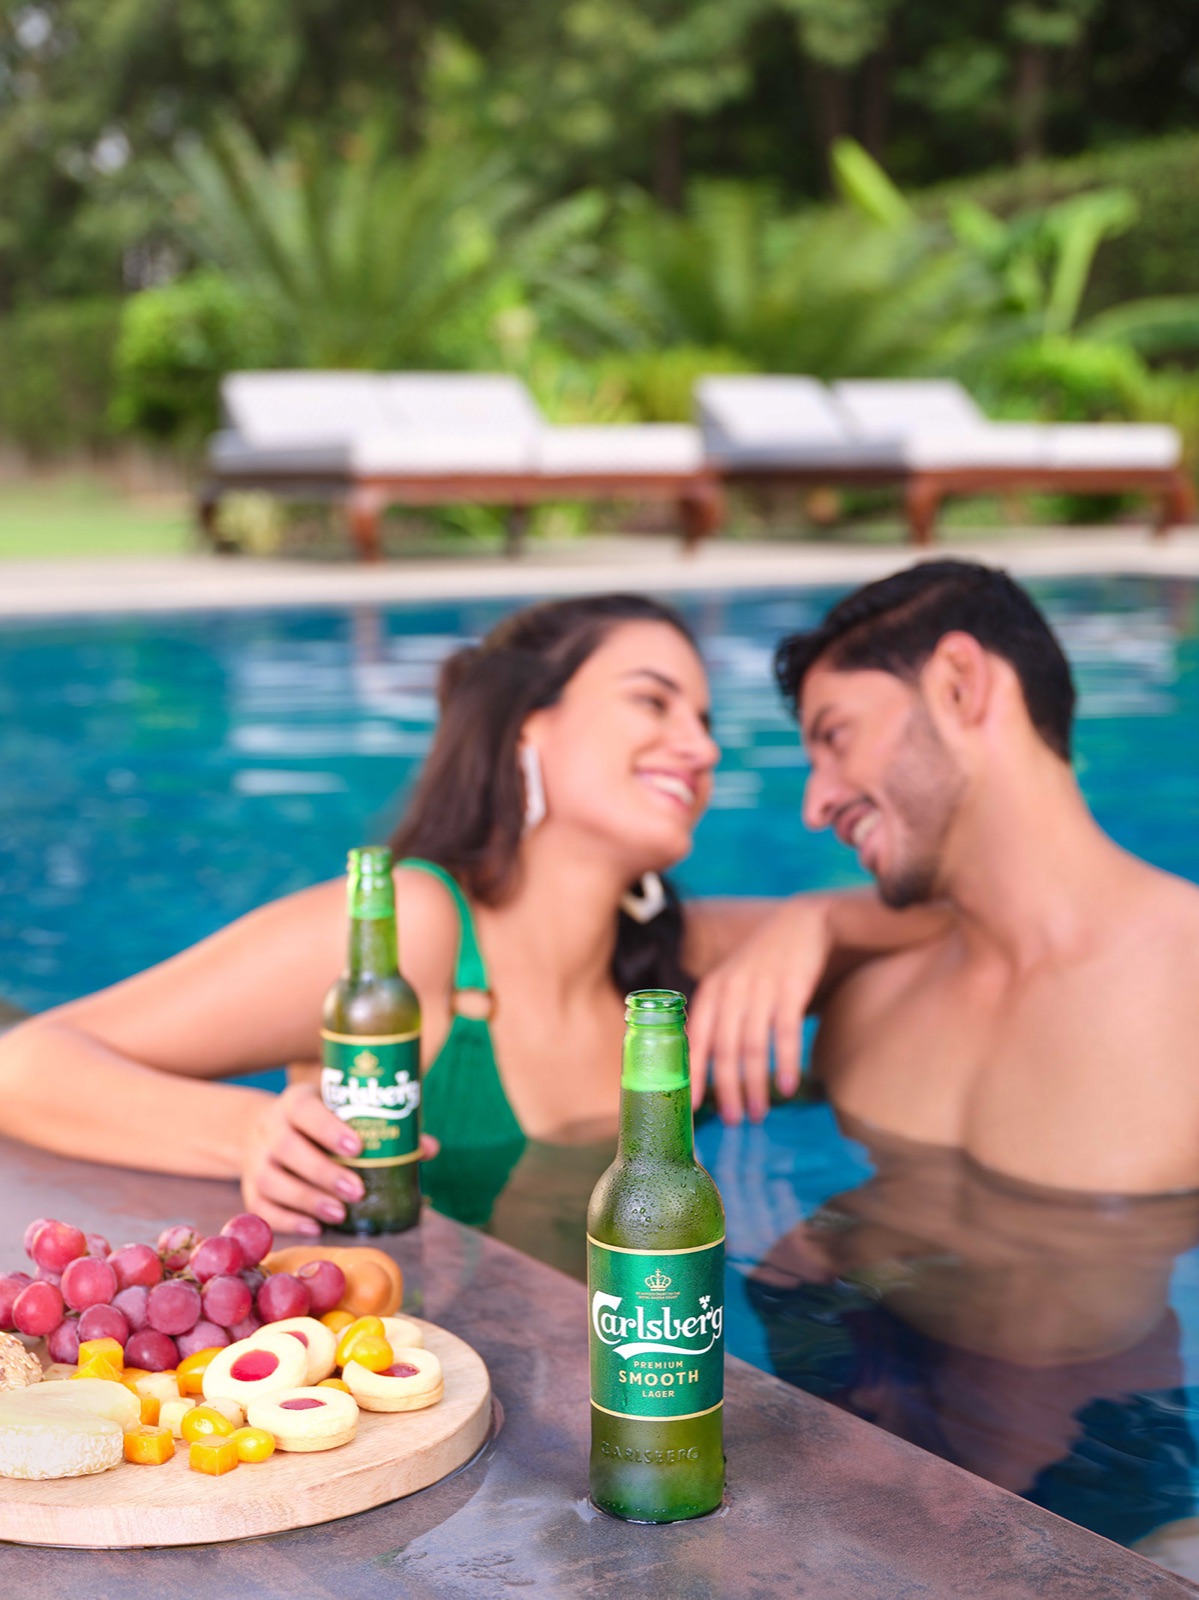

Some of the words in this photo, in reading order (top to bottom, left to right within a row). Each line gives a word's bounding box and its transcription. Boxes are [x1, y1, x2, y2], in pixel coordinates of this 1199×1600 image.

[592, 1290, 724, 1346] Carlsberg
[633, 1360, 684, 1369] PREMIUM
[618, 1369, 699, 1387] SMOOTH
[642, 1389, 675, 1398] LAGER
[601, 1441, 699, 1463] CARLSBERG
